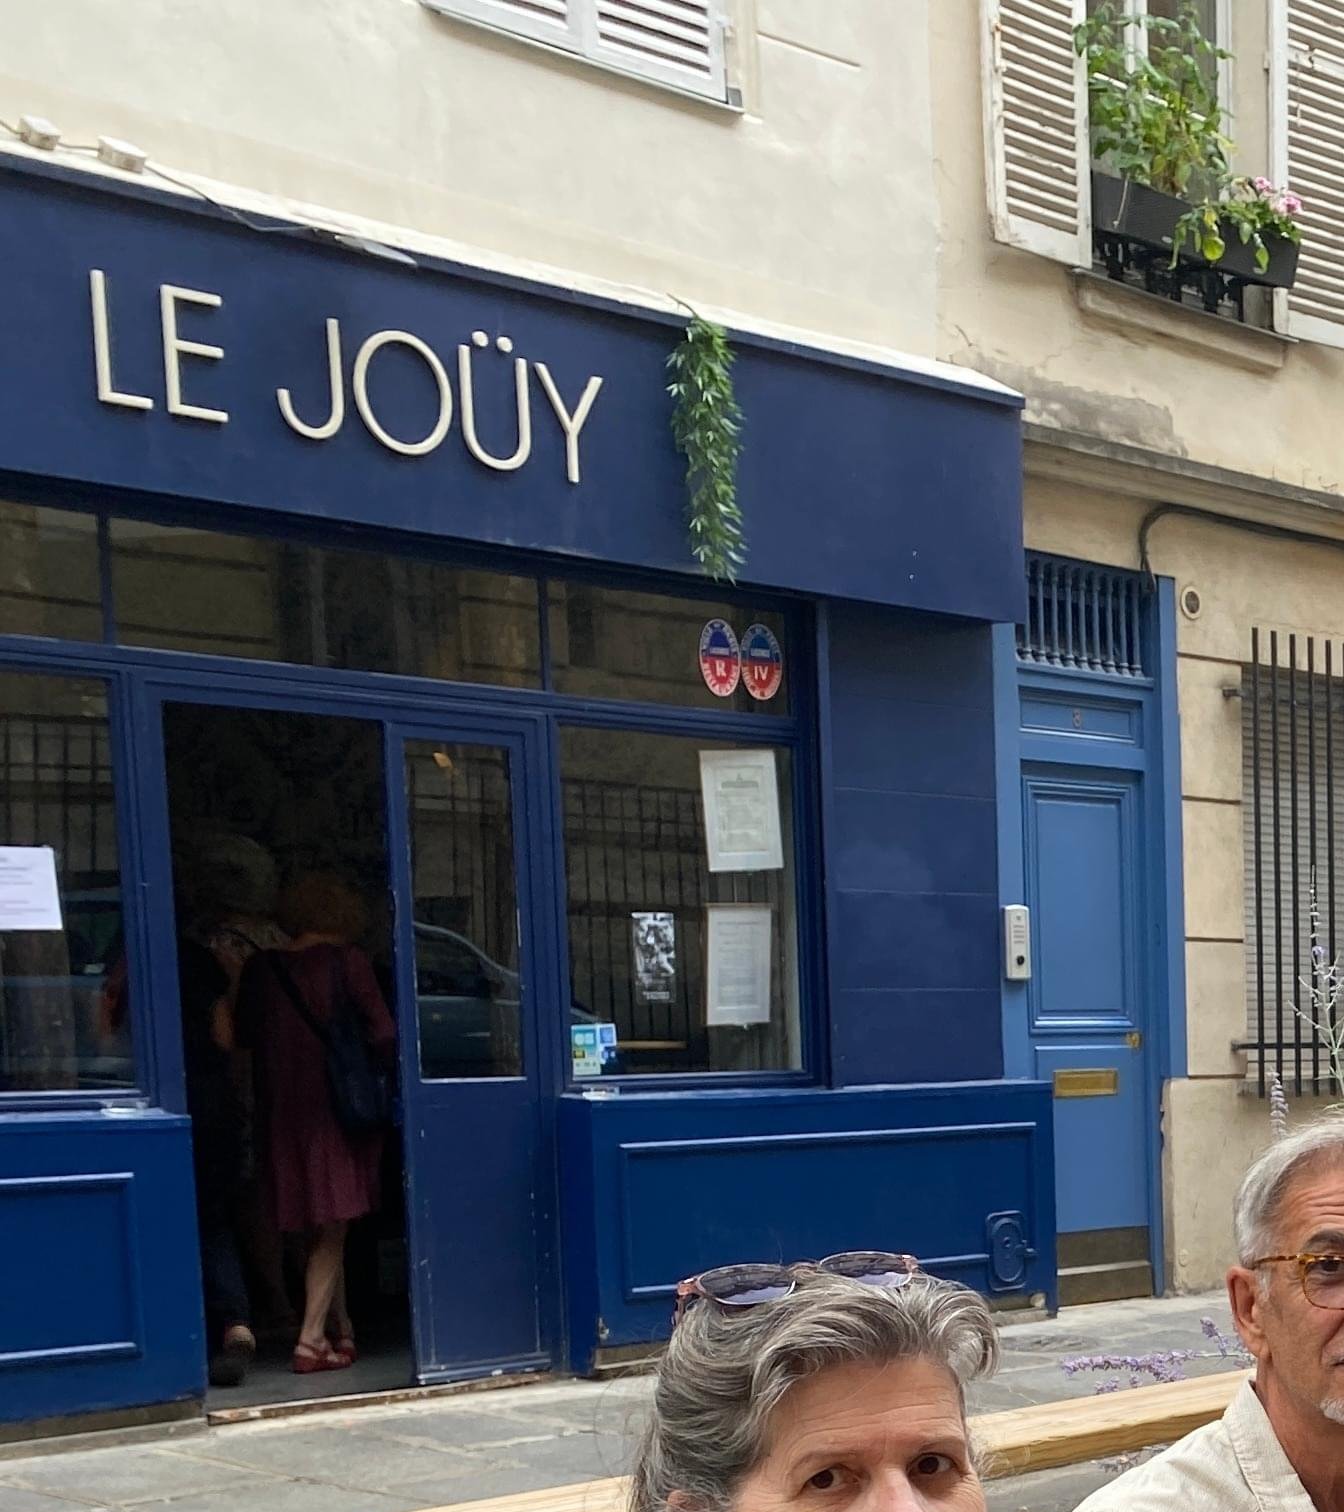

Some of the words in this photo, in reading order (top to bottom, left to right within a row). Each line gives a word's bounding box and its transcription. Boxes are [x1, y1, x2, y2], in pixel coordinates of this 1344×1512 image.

[90, 269, 229, 423] LE
[276, 317, 603, 484] JOÜY
[715, 660, 727, 677] R
[754, 665, 769, 680] IV
